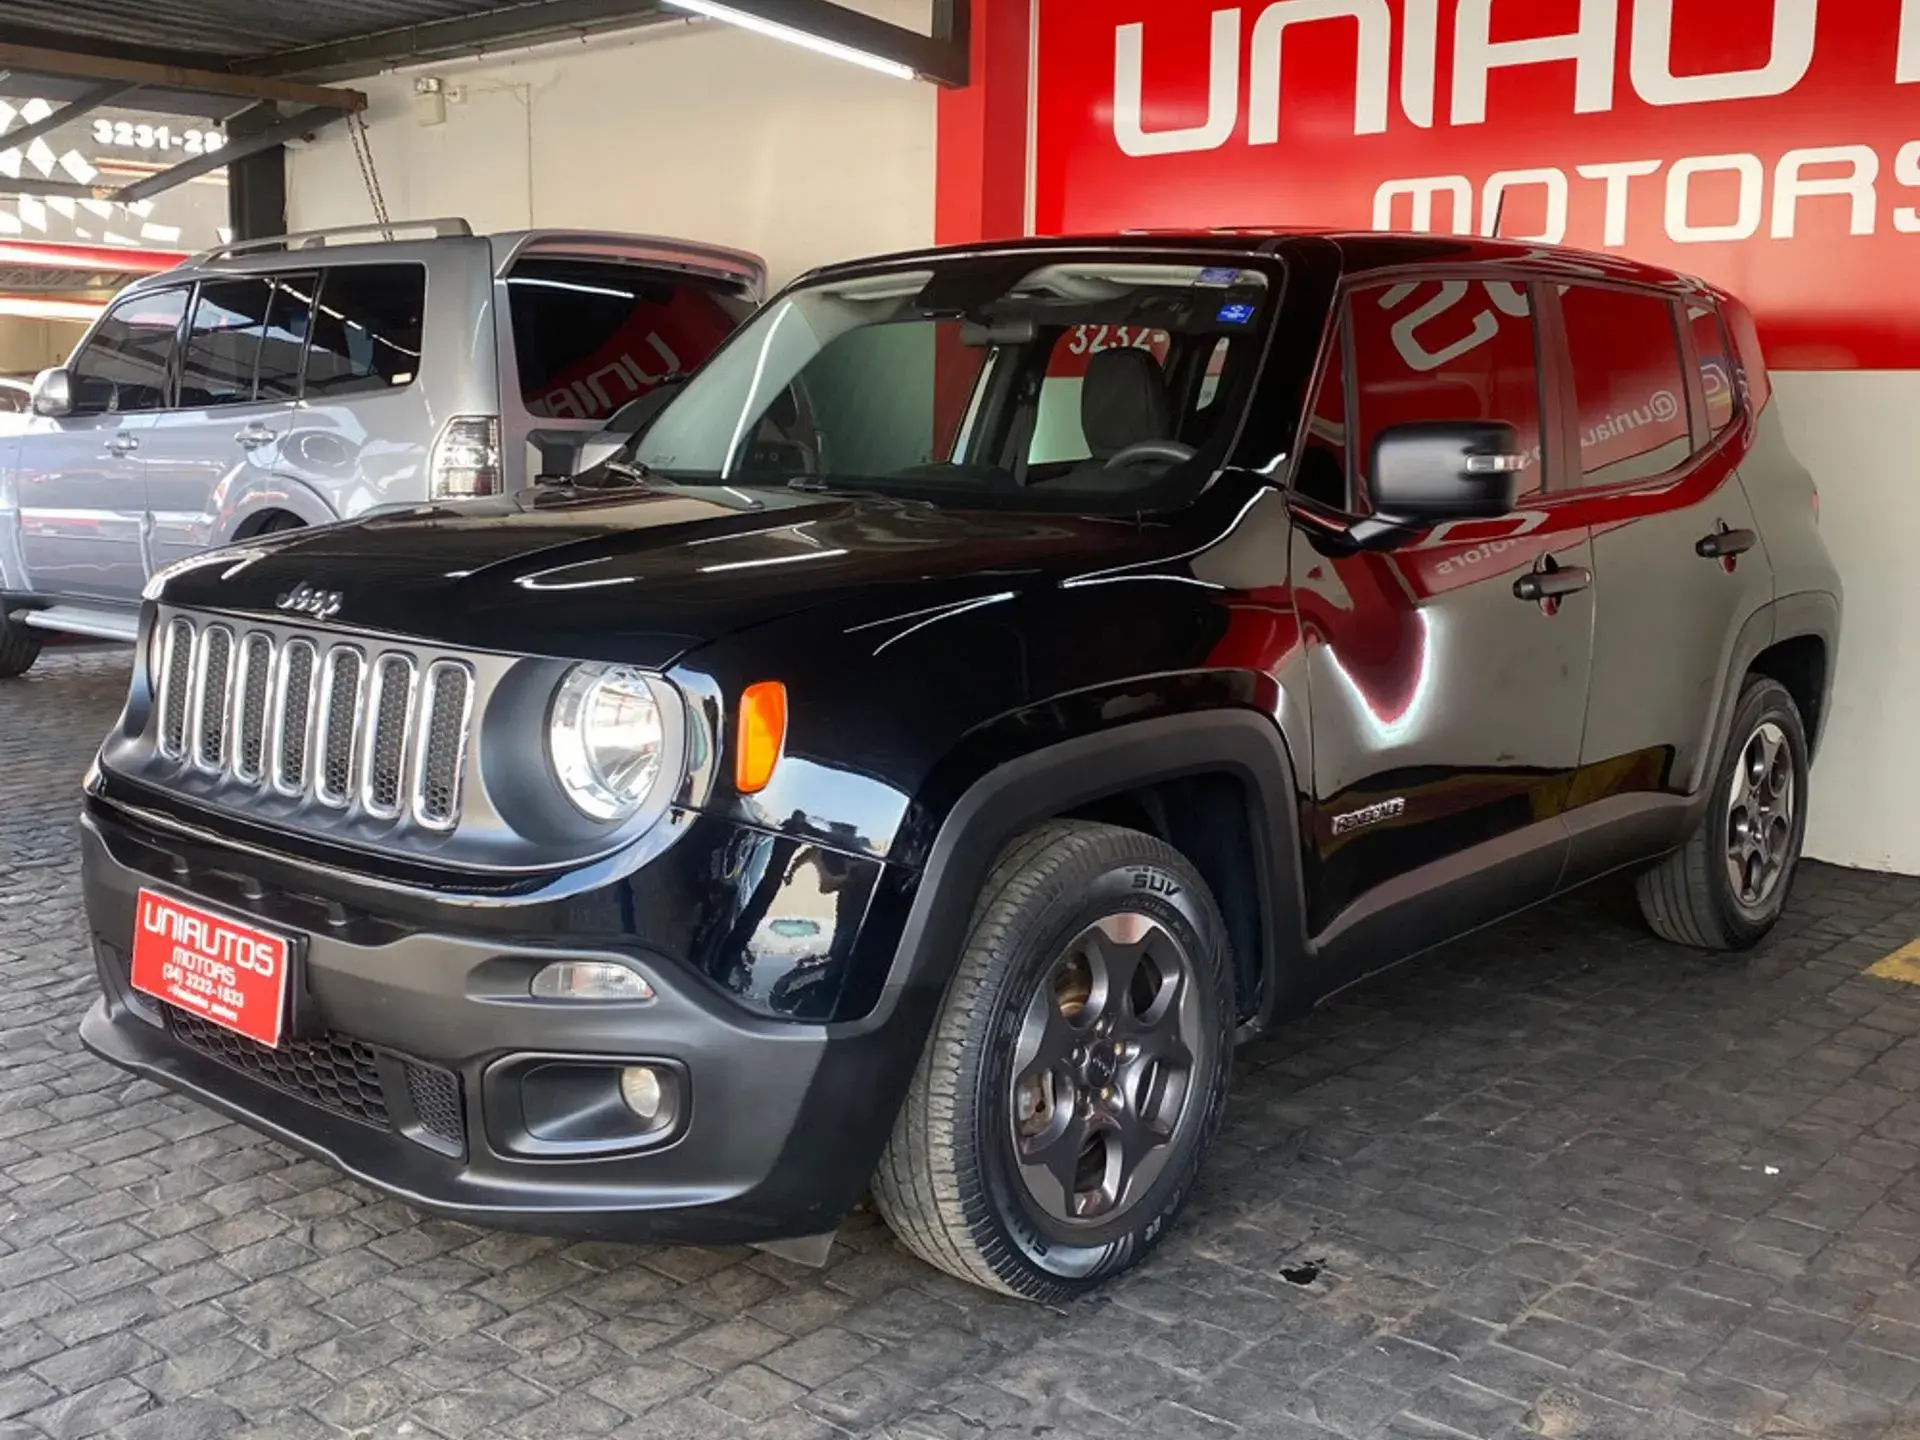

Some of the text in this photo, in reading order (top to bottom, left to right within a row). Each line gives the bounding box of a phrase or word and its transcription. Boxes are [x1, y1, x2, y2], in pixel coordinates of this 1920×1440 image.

[274, 580, 343, 620] Jeep
[1131, 873, 1181, 896] SUV
[143, 900, 275, 978] UNIAUTOS
[172, 945, 237, 987] MOTORS
